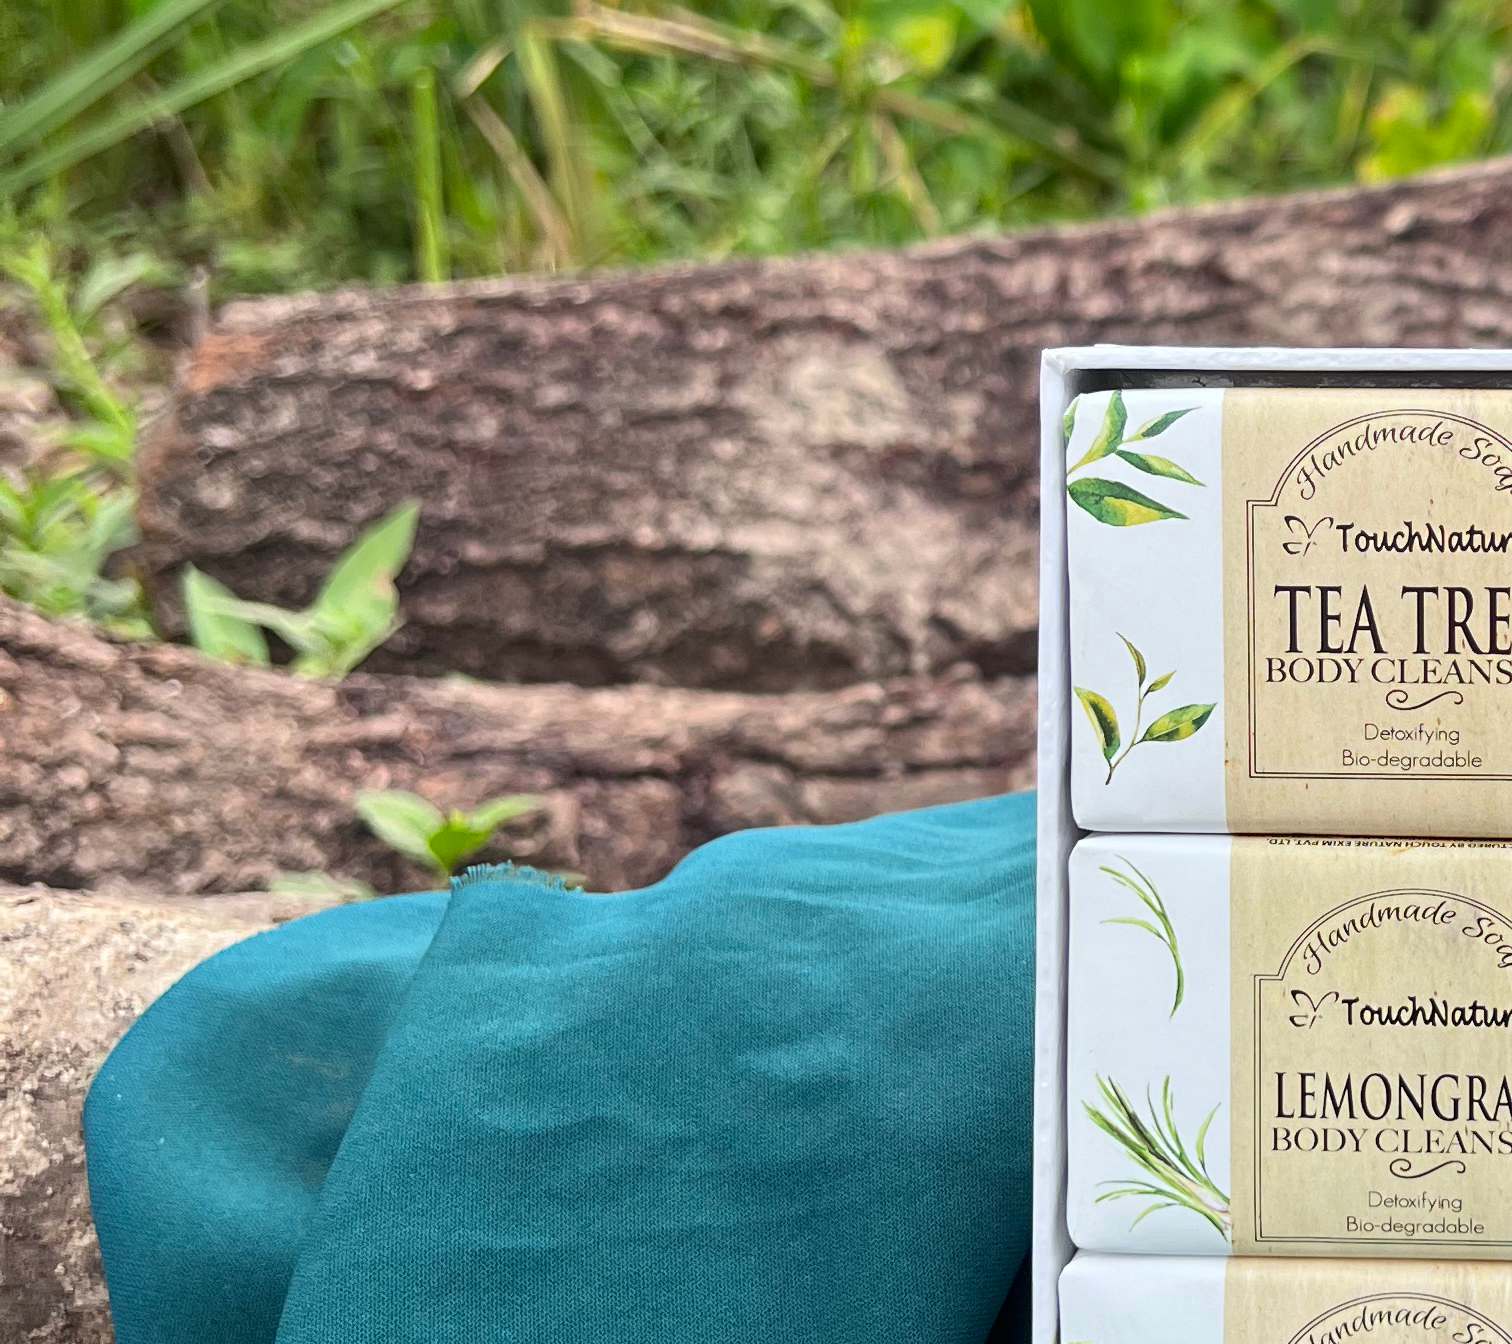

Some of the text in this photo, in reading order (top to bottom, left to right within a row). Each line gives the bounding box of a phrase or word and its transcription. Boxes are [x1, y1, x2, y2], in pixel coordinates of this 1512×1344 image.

[1297, 422, 1453, 499] Handmade
[1274, 585, 1387, 654] TEA
[1266, 658, 1364, 685] BODY
[1364, 723, 1460, 745] Detoxifying
[1342, 749, 1482, 770] Bio-degradable
[1302, 901, 1457, 975] Handmade
[1271, 1127, 1369, 1153] BODY
[1368, 1191, 1462, 1213] Detoxifying
[1347, 1216, 1484, 1236] Bio-degradable
